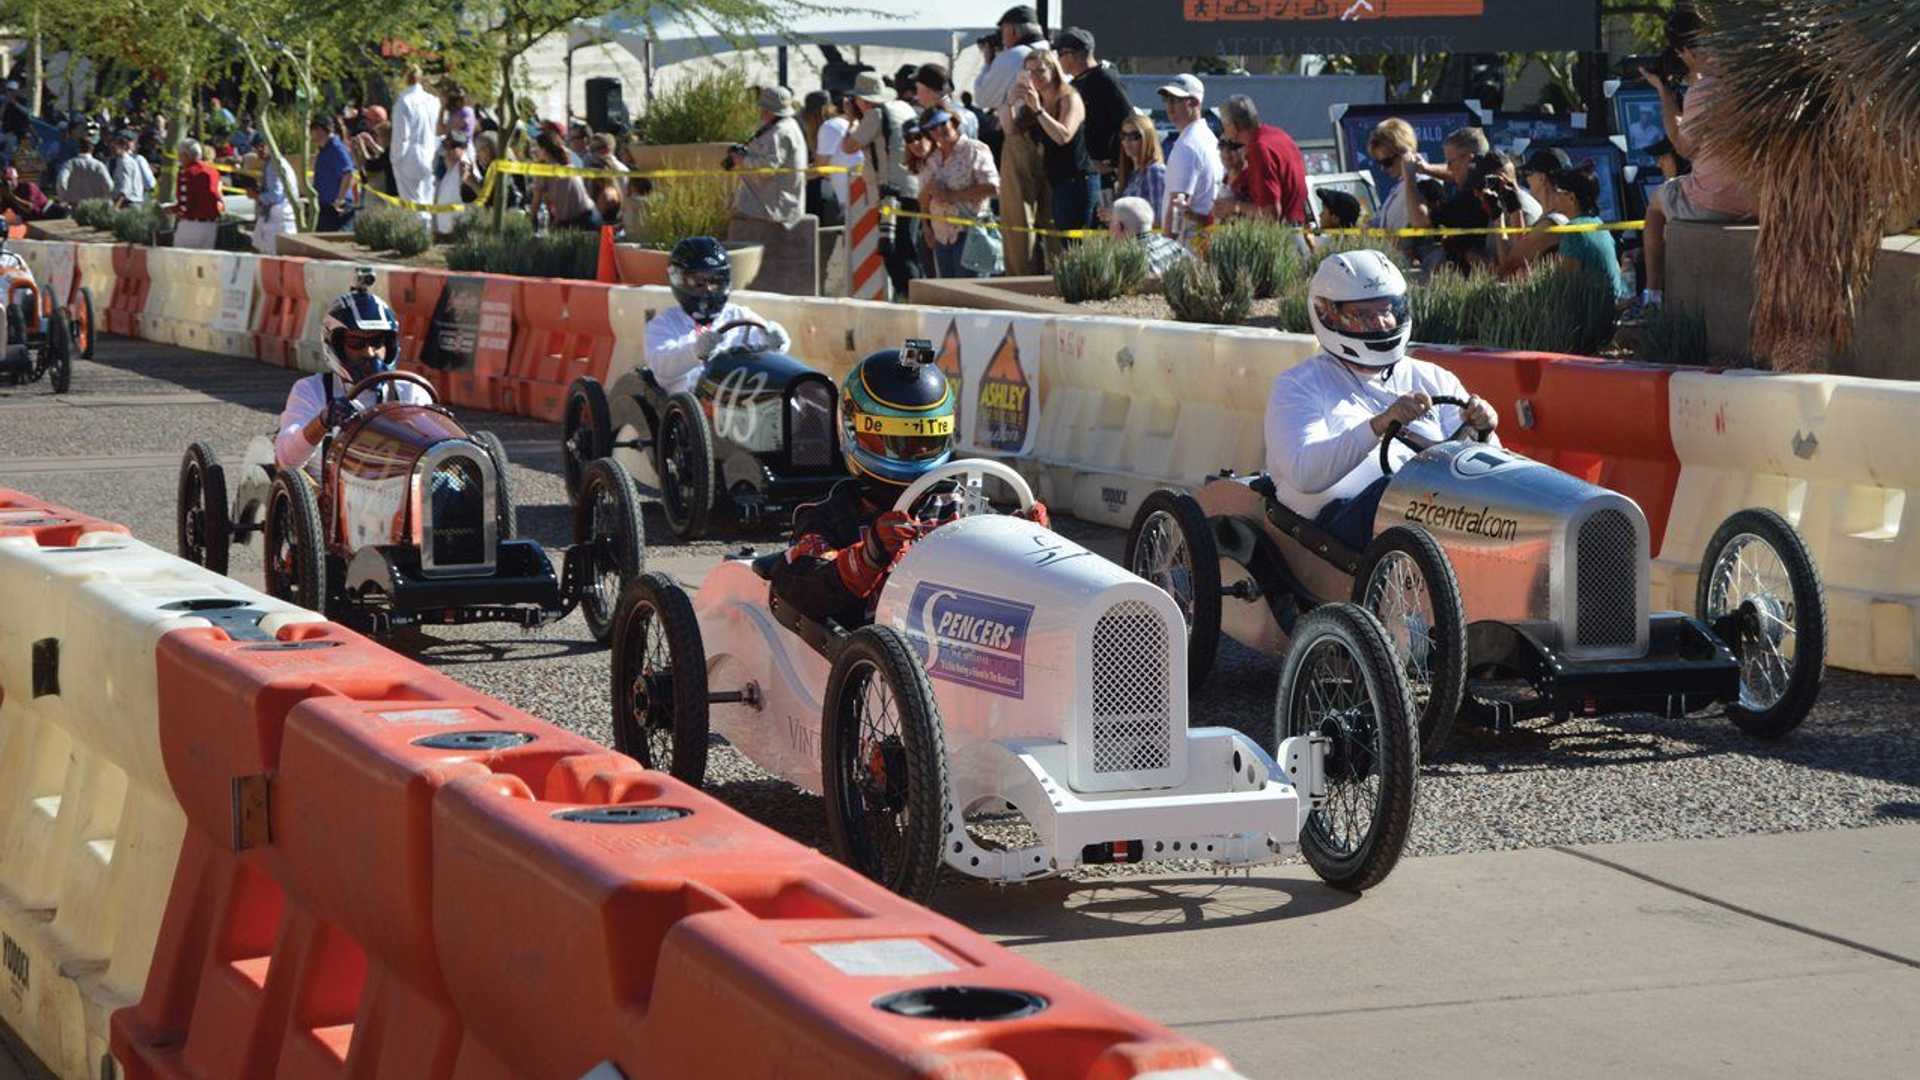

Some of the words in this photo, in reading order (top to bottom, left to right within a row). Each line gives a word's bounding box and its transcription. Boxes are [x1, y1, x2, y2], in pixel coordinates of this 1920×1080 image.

[1251, 35, 1376, 55] TALKING
[1381, 35, 1457, 55] STICK
[981, 382, 1028, 412] ASHLEY
[927, 418, 949, 434] Tre
[922, 589, 1015, 672] SPENCERS
